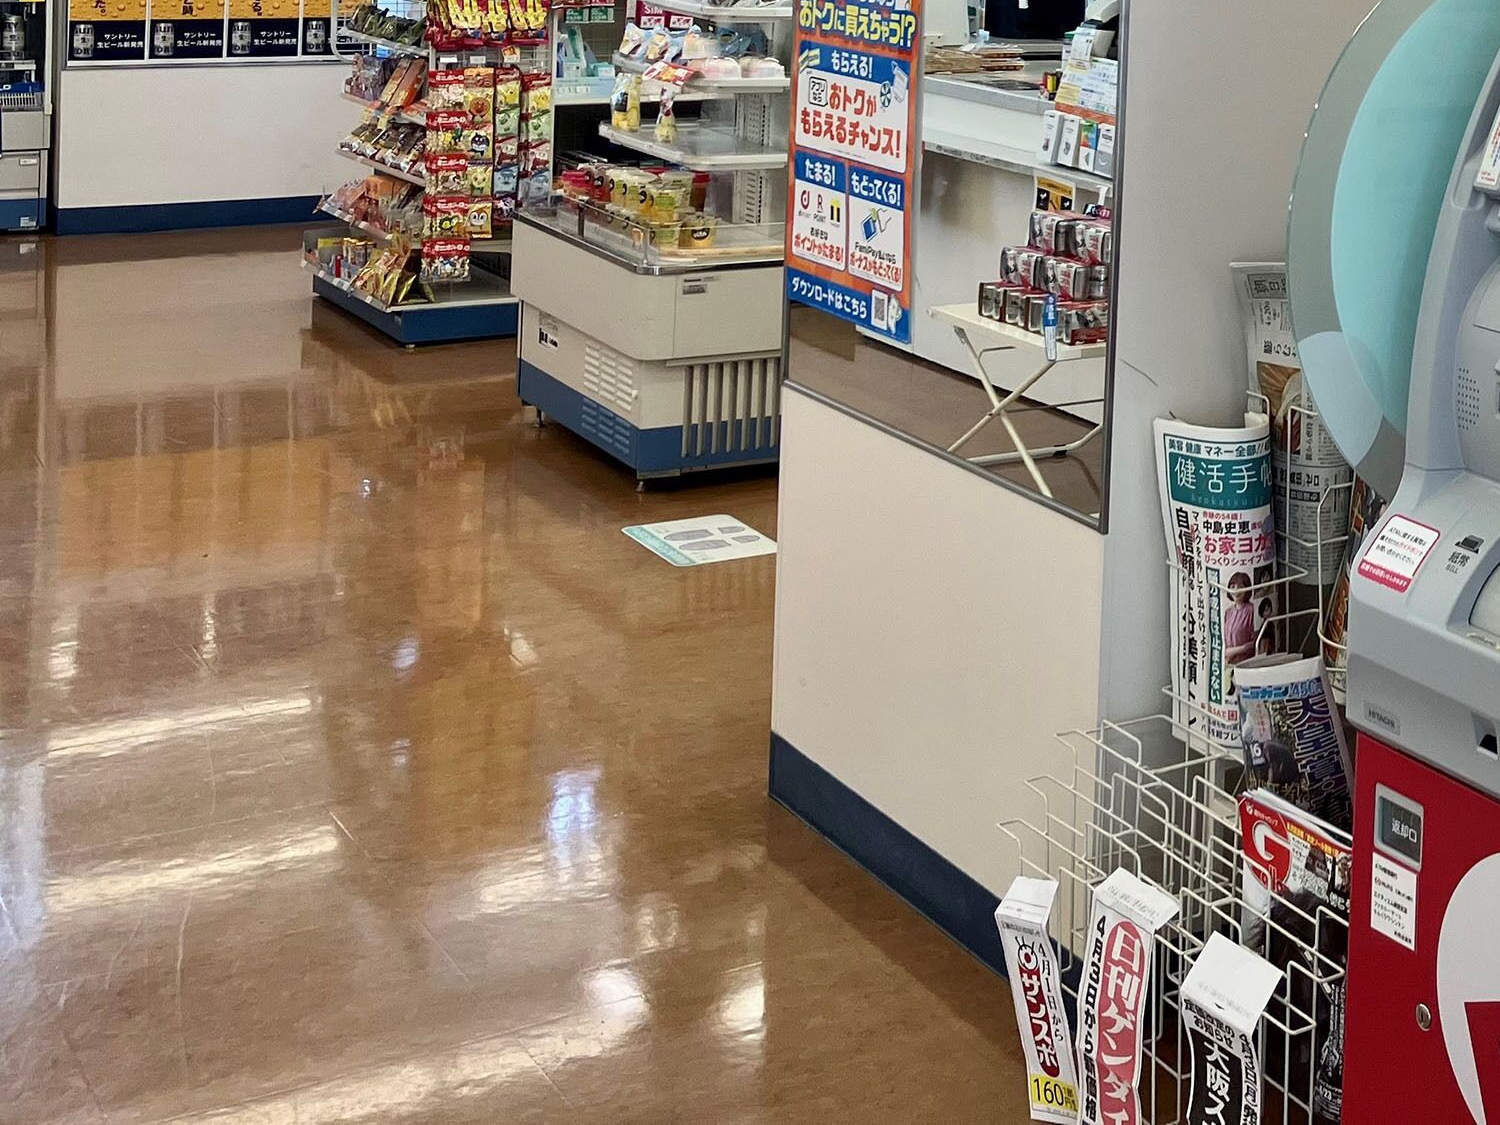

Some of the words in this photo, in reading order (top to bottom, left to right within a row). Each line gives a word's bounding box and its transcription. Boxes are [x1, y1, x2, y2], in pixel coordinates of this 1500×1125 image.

[103, 32, 138, 40] サントリー
[183, 31, 216, 39] サントリー
[260, 30, 292, 38] サントリー
[831, 50, 873, 78] もらえる!
[829, 83, 877, 117] おトクが
[801, 107, 900, 158] もらえるチャンス!
[805, 158, 836, 186] たまる!
[851, 172, 901, 207] もどってくる!
[794, 233, 844, 266] ポイントがたまる!
[791, 276, 868, 320] ダウンロードはこちら
[1202, 520, 1251, 535] 中島史恵
[1368, 708, 1396, 730] HITACHI
[1391, 818, 1418, 844] 返却口
[1019, 972, 1060, 1072] サンスポ
